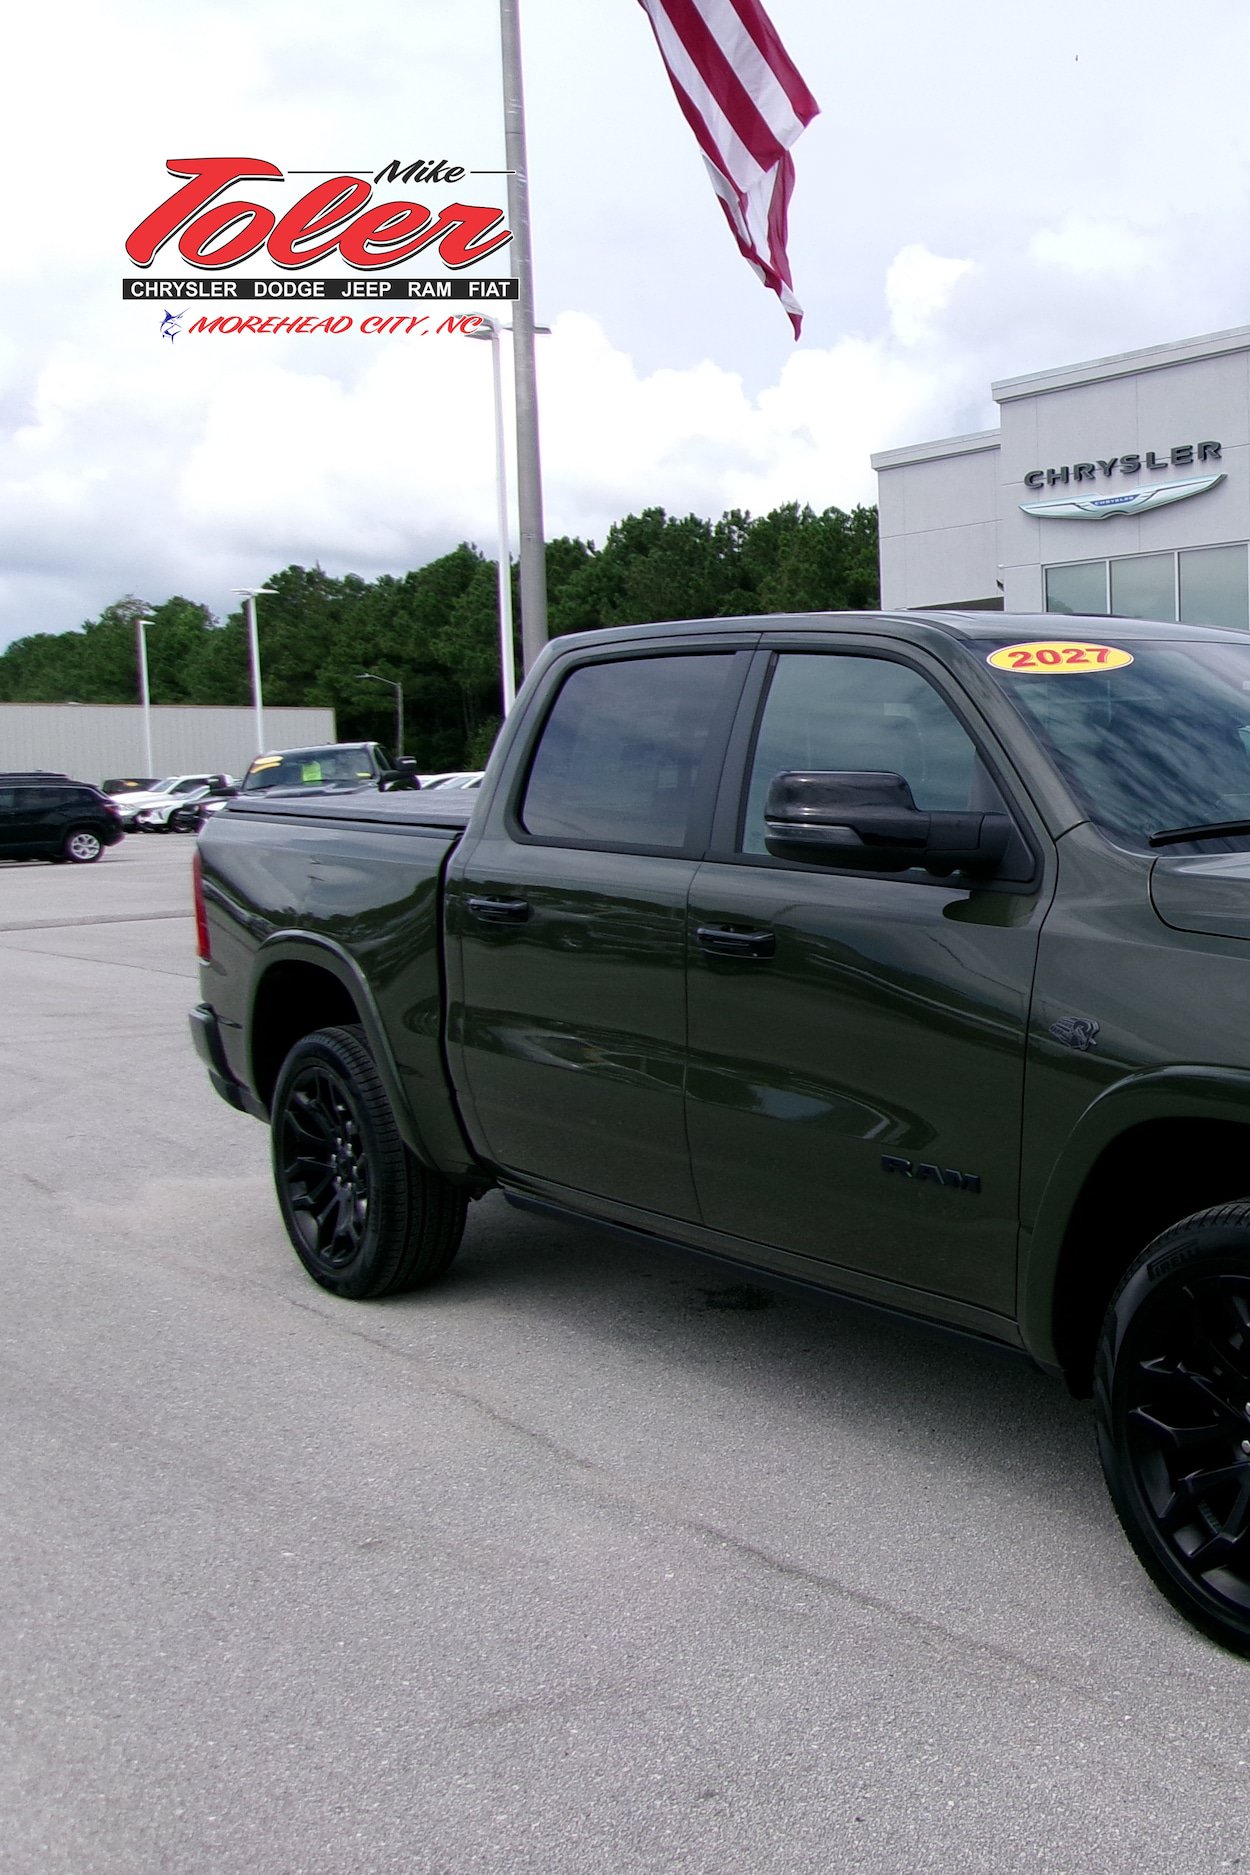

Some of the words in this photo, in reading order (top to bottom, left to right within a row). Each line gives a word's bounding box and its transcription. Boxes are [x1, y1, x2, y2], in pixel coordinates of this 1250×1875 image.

[1023, 440, 1223, 489] CHRYSLER
[1007, 648, 1110, 668] 2027
[881, 1154, 982, 1194] RAM
